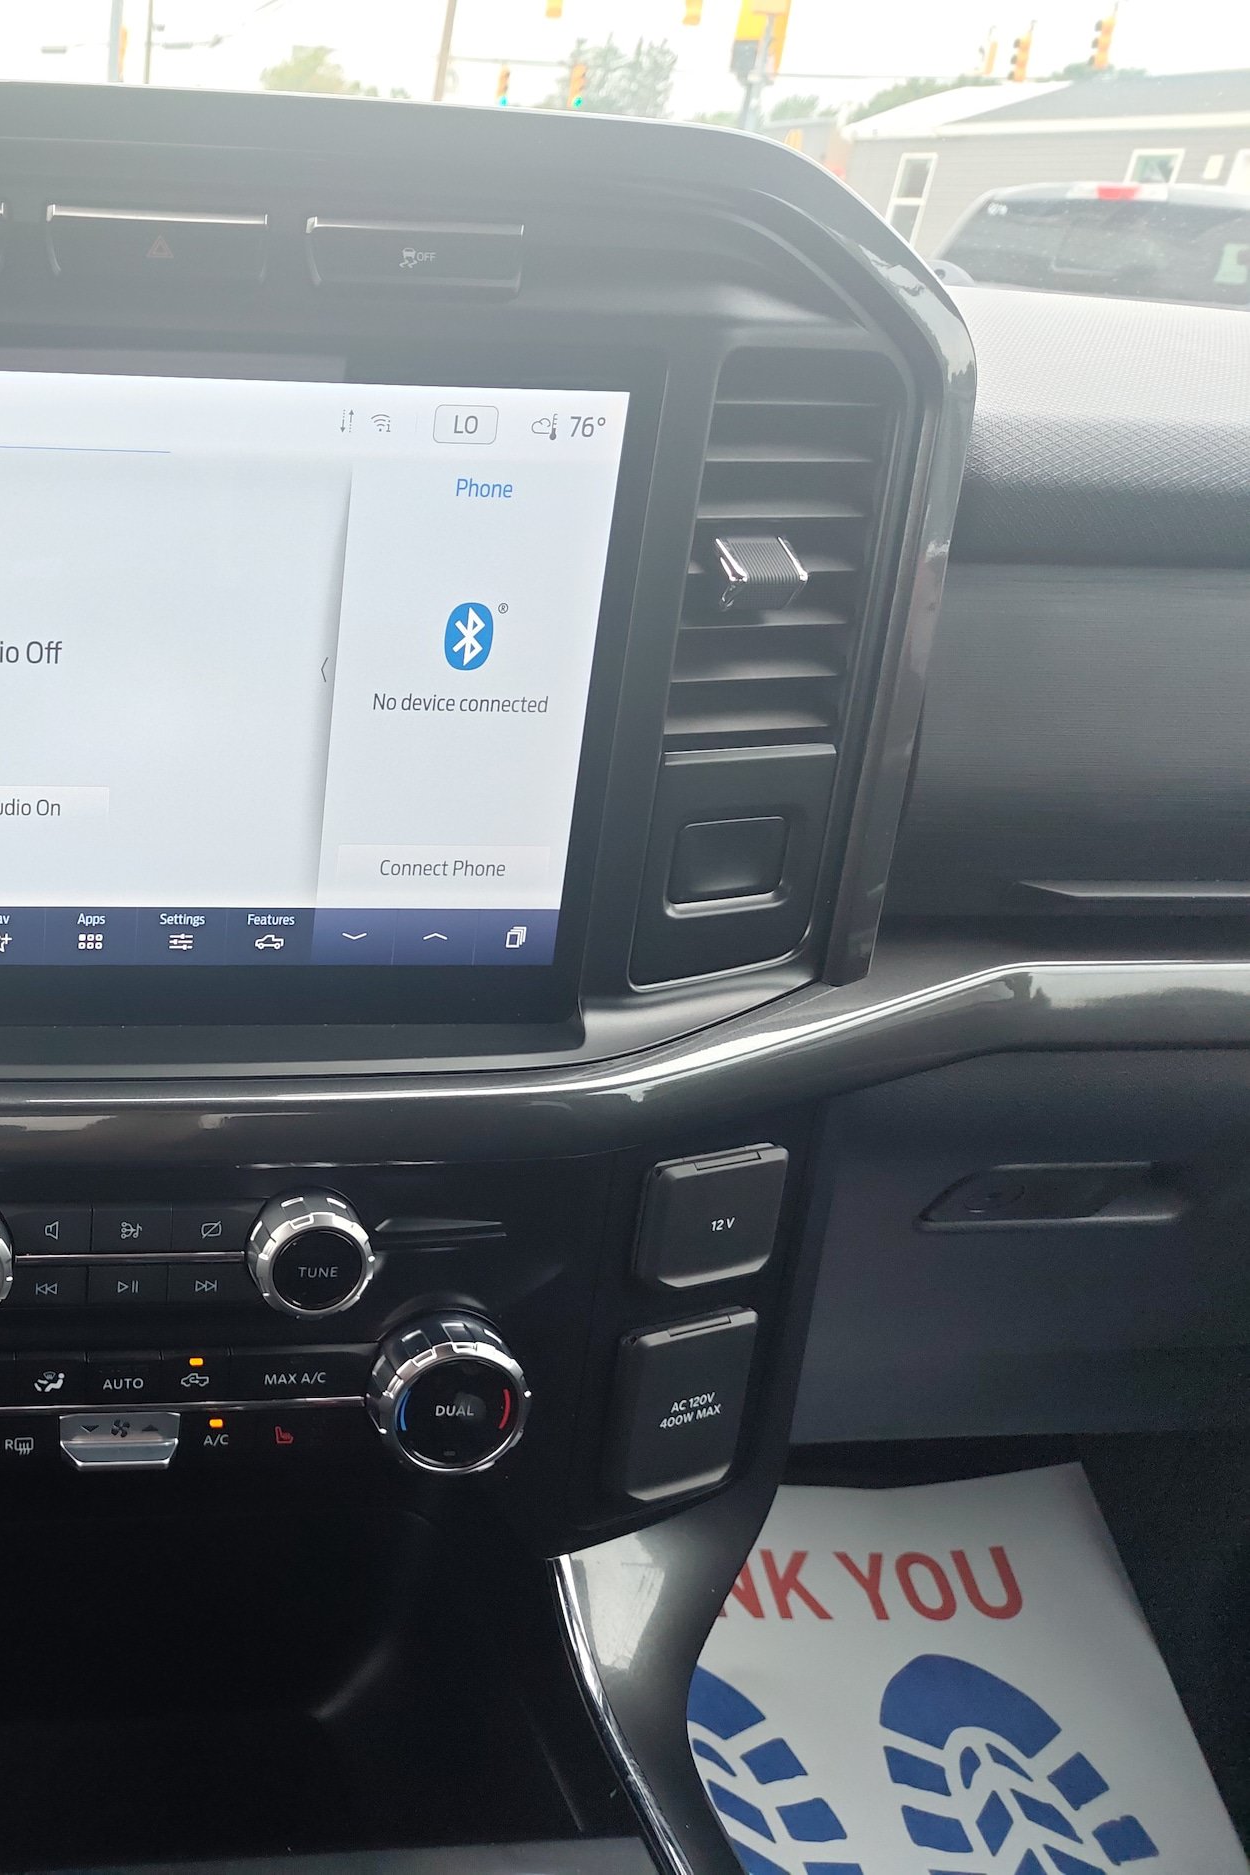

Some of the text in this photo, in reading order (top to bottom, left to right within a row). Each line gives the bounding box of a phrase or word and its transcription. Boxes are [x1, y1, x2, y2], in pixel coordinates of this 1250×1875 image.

[416, 251, 436, 262] OFF
[453, 415, 479, 435] LO
[455, 478, 513, 498] Phone
[25, 640, 63, 665] Off
[372, 693, 548, 713] No device connected
[36, 799, 61, 817] On
[379, 859, 506, 877] Connect Phone
[77, 913, 106, 929] Apps
[159, 913, 206, 927] Settings
[247, 913, 295, 926] Features
[710, 1217, 736, 1232] 12 V
[298, 1266, 339, 1279] TUNE
[103, 1377, 145, 1391] AUTO
[264, 1371, 327, 1386] MAX A/C
[435, 1404, 475, 1418] DUAL
[670, 1392, 716, 1414] AC 120V
[659, 1404, 722, 1430] 400W MAX
[203, 1434, 230, 1446] A/C
[831, 1545, 1024, 1622] YOU
